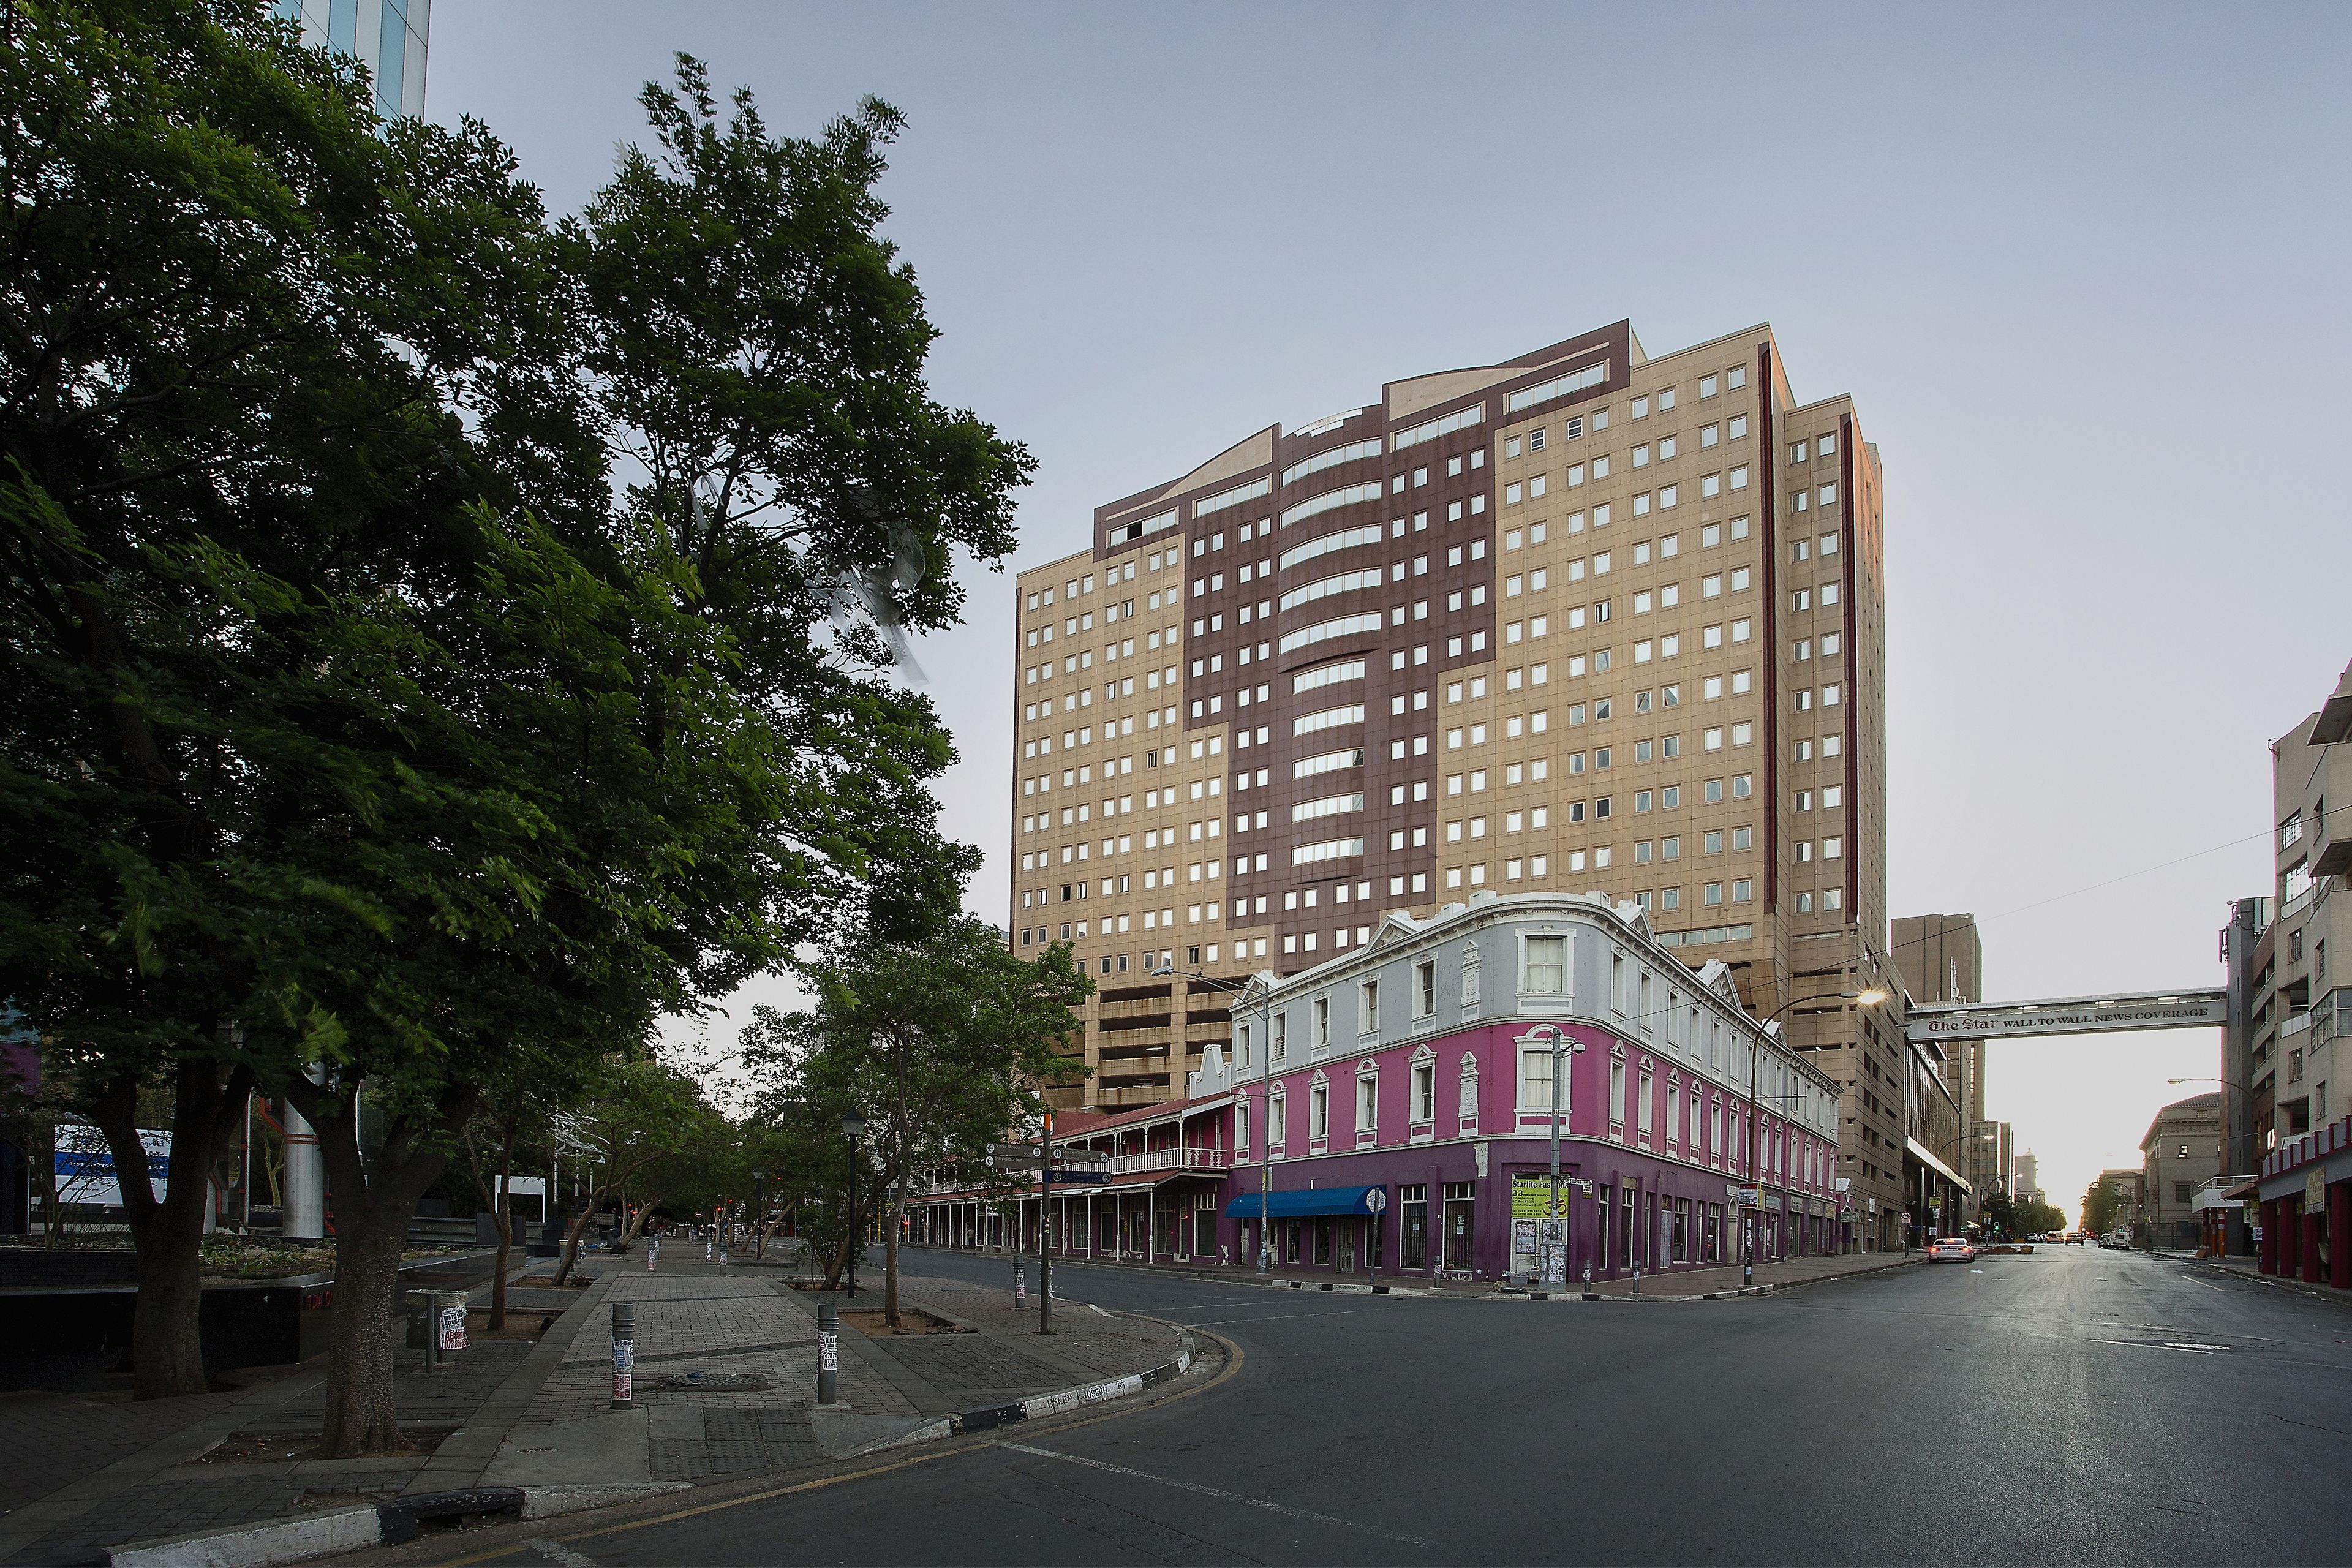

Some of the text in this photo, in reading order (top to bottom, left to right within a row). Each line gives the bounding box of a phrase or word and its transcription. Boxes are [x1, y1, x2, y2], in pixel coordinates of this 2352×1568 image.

[1928, 1020, 1959, 1032] The
[1962, 1018, 1997, 1030] Star
[2003, 1019, 2037, 1028] WALL
[2057, 1016, 2092, 1025] WALL
[2095, 1013, 2132, 1022] NEWS
[2135, 1008, 2208, 1020] COVERAGE
[444, 1340, 454, 1349] 073
[1047, 1394, 1072, 1408] HELEN
[1082, 1385, 1108, 1400] JOSEPH
